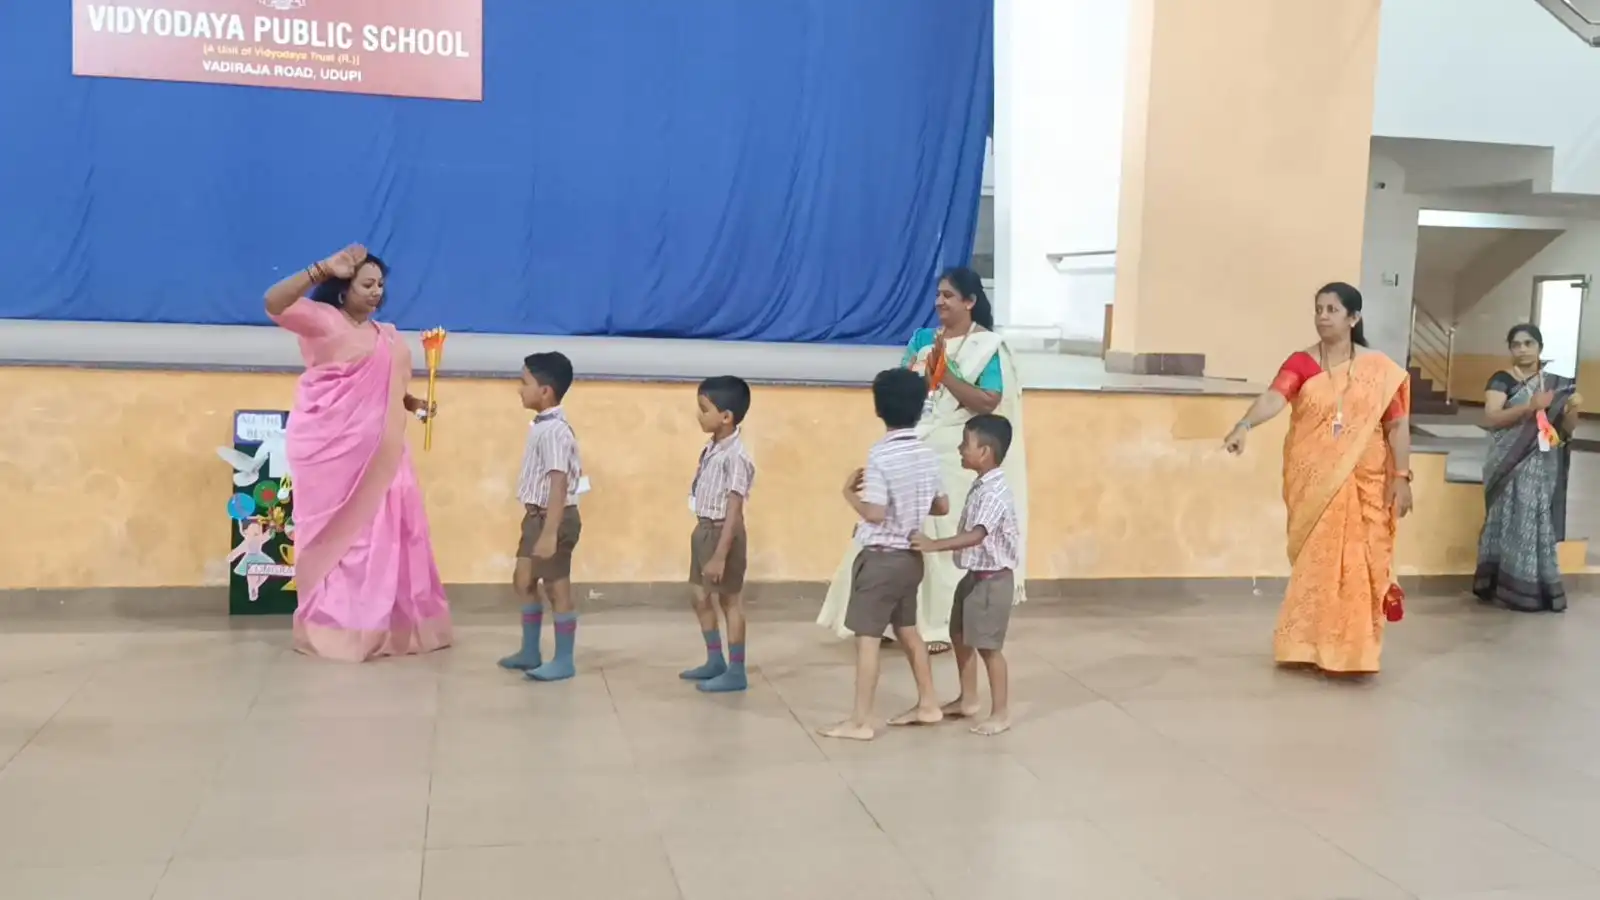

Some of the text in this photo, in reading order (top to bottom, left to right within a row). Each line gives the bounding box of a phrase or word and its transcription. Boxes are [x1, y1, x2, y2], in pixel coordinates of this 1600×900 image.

[87, 4, 469, 57] VIDYODAYA PUBLIC SCHOOL
[202, 60, 362, 82] VADIRAJA ROAD, UDUPI
